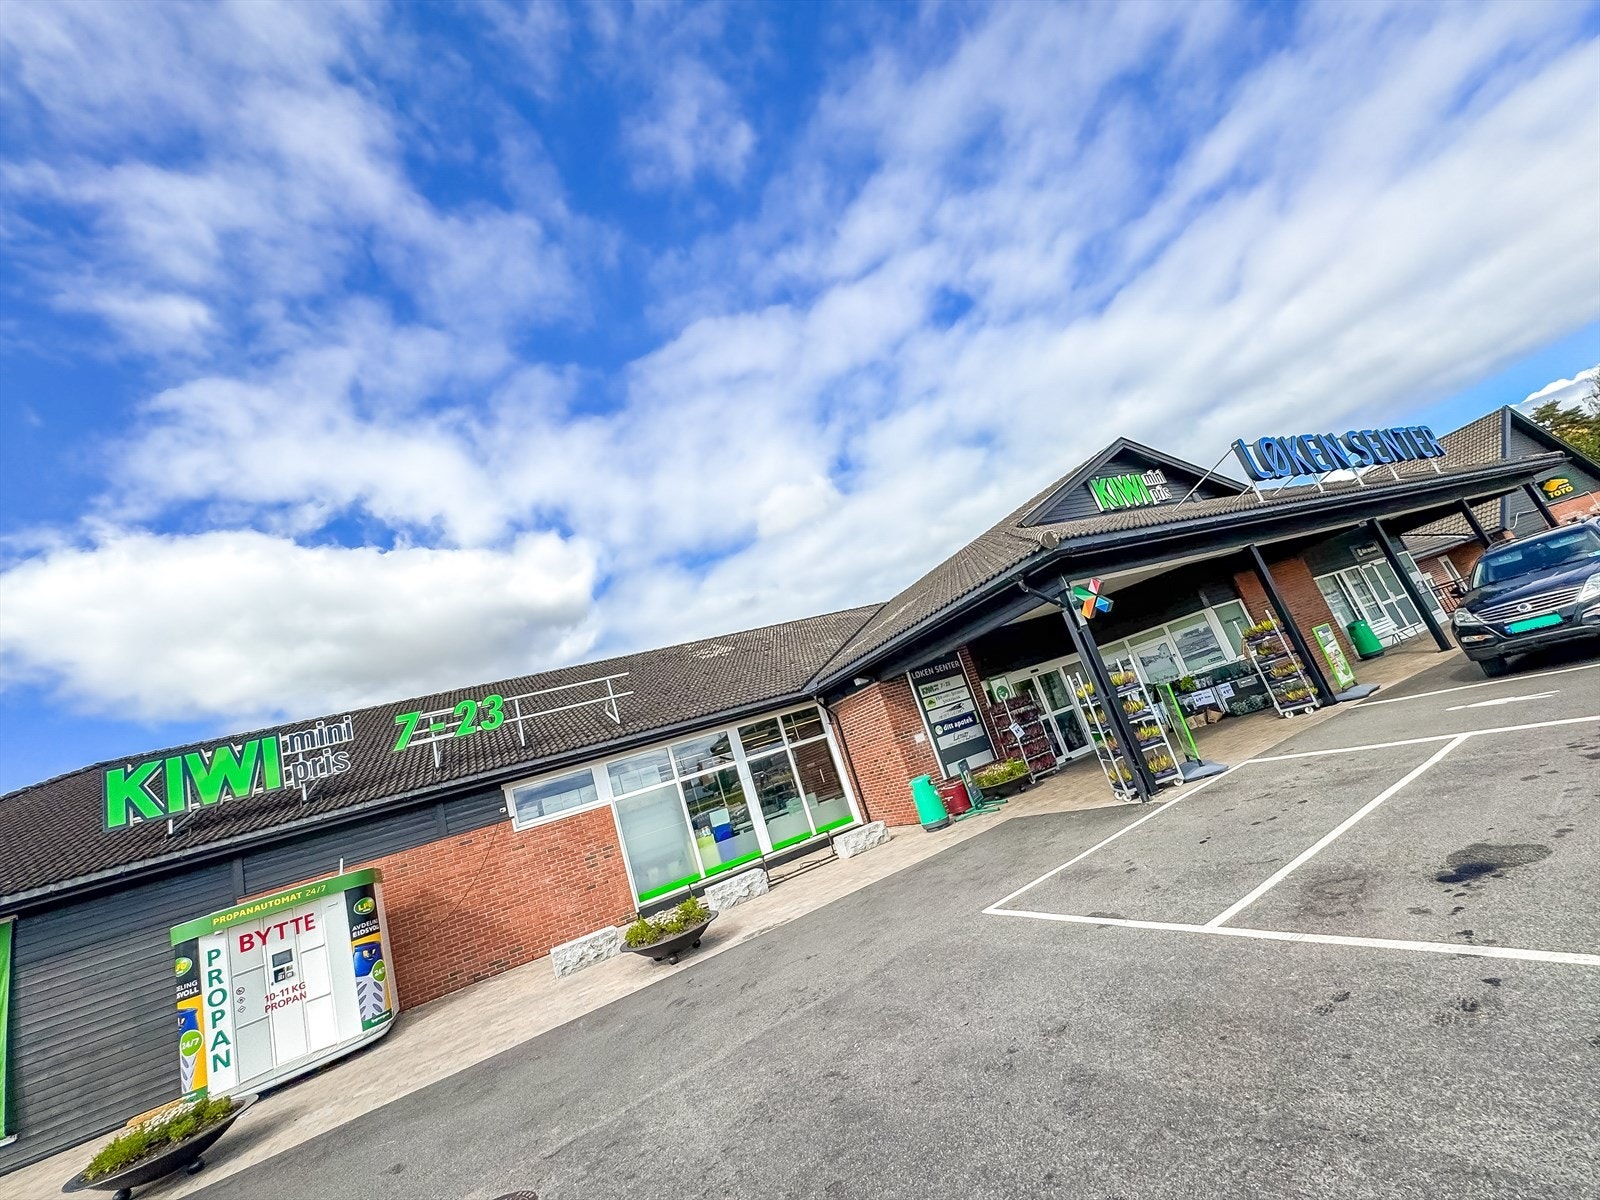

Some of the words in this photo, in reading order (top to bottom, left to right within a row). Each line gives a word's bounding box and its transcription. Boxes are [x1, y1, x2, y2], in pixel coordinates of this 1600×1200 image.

[1234, 432, 1352, 480] LØKEN
[1346, 425, 1447, 466] SENTER
[1089, 474, 1153, 510] KIWI
[1142, 469, 1167, 487] mini
[1149, 485, 1173, 505] pris
[1548, 486, 1574, 498] TOTO
[934, 660, 960, 673] SENTER
[288, 714, 354, 752] mini
[393, 710, 422, 752] 7
[453, 694, 505, 738] 23
[103, 733, 284, 831] KIWI
[291, 749, 351, 789] pris
[212, 891, 302, 926] PROPANAUTOMAT
[305, 885, 326, 897] 24/7
[238, 912, 316, 953] BYTTE
[206, 948, 232, 1073] PROPAN
[264, 987, 290, 1003] 10-11
[291, 981, 307, 993] KG
[264, 991, 307, 1014] PROPAN
[181, 1036, 200, 1051] 24/7
